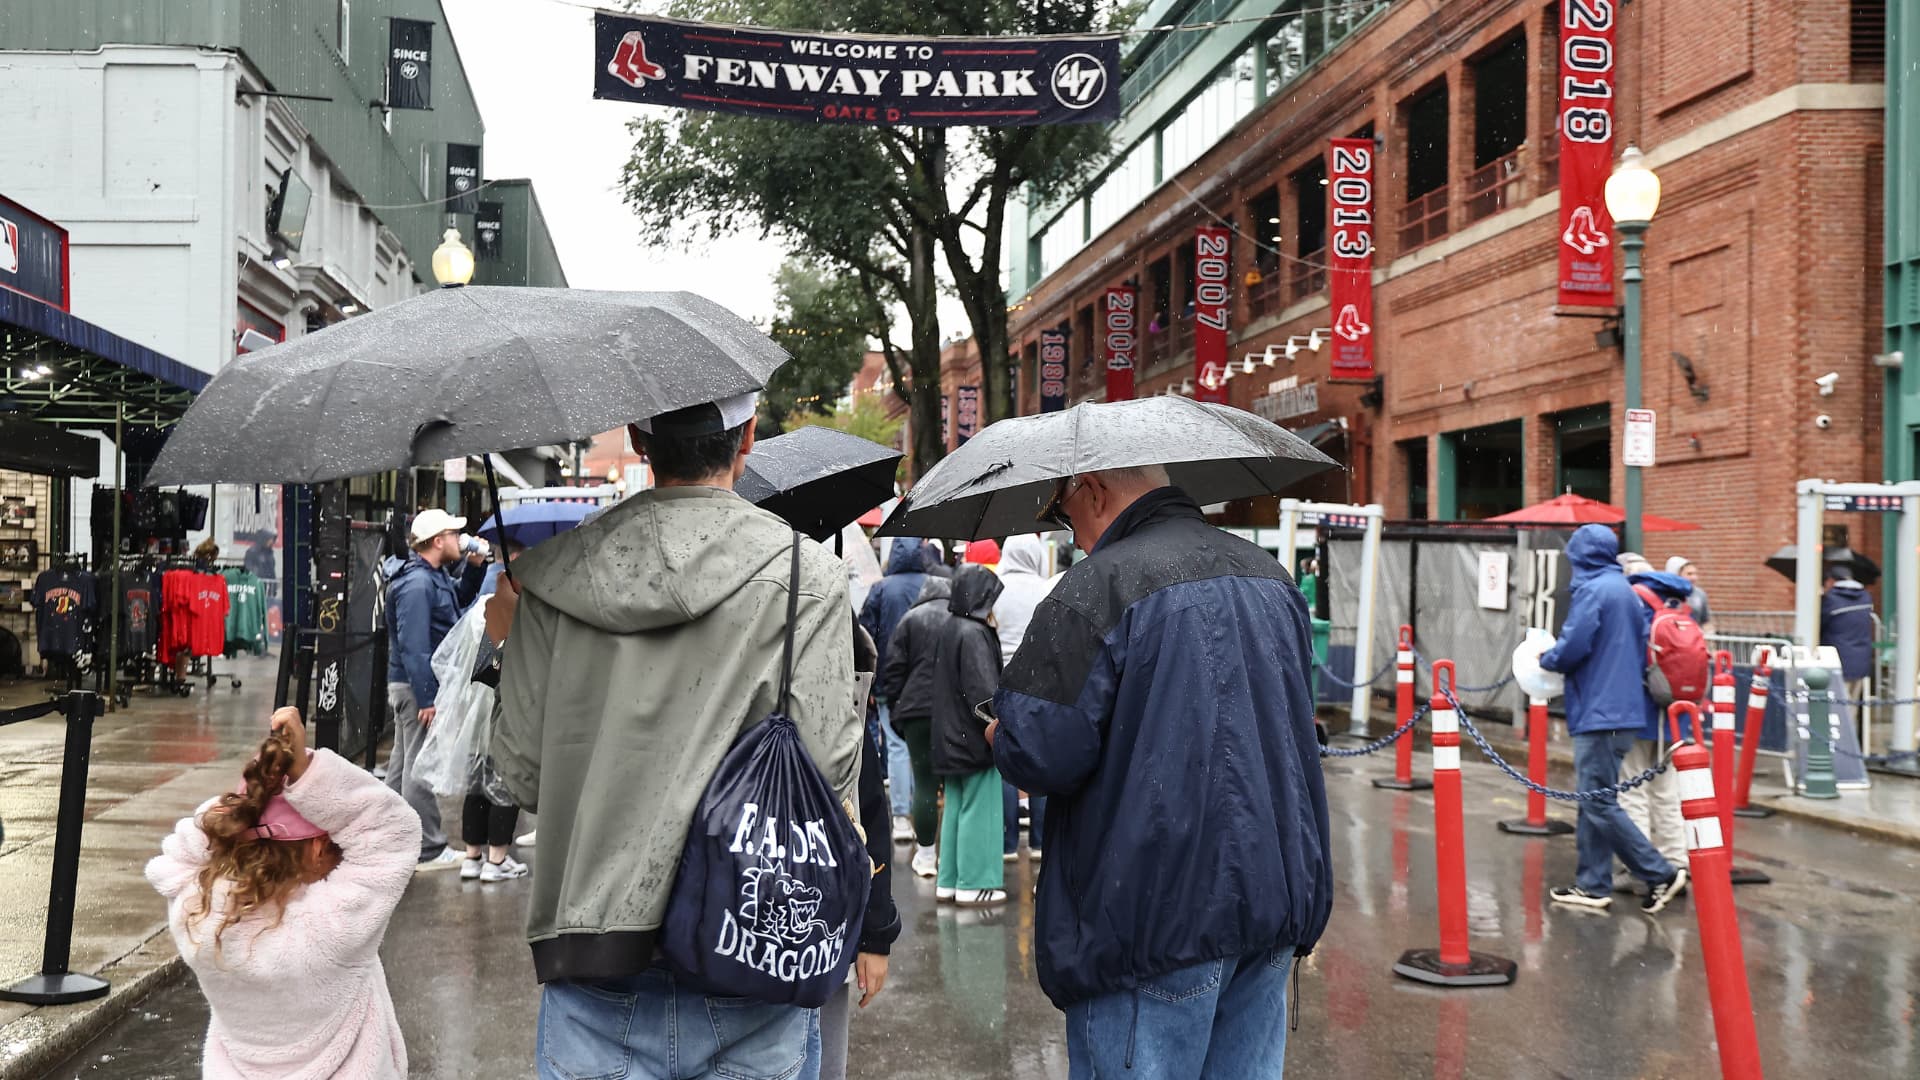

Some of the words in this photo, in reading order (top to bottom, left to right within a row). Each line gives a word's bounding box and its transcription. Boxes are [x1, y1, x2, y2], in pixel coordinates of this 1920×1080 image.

[393, 48, 428, 61] SINCE
[683, 54, 890, 96] FENWAY
[900, 69, 1038, 98] PARK
[791, 40, 897, 60] WELCOME
[906, 45, 933, 60] TO
[1564, 0, 1613, 143] 2018
[823, 106, 882, 121] GATE
[886, 108, 900, 121] D
[450, 166, 476, 177] SINCE
[477, 221, 500, 230] SINCE
[1333, 146, 1371, 258] 2013
[1197, 234, 1227, 331] 2007
[1107, 292, 1135, 371] 2004
[1041, 333, 1066, 397] 1986
[714, 909, 847, 982] DRAGONS
